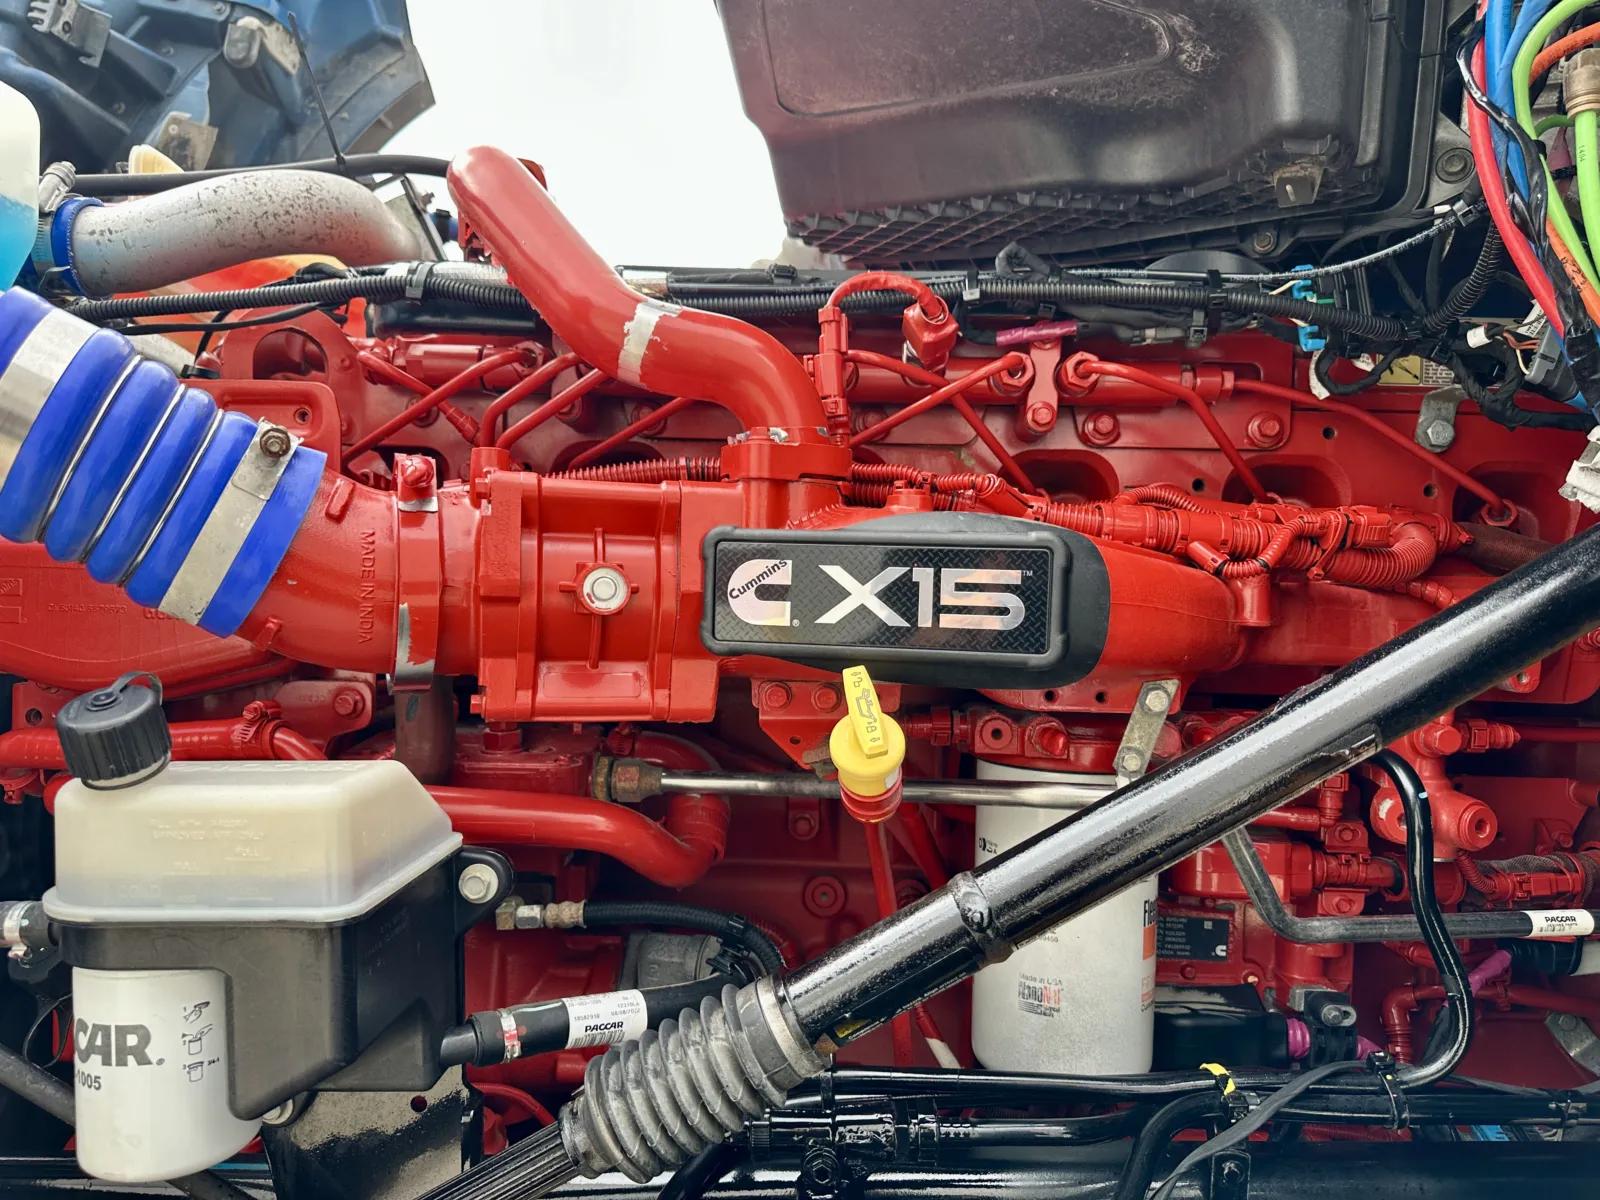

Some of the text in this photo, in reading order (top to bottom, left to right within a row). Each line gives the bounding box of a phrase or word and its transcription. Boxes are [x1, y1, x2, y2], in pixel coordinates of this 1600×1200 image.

[359, 531, 375, 645] MADE IN INDIA
[728, 558, 788, 600] Cummins
[1544, 915, 1577, 923] PACCAR
[585, 1021, 624, 1033] PACCAR
